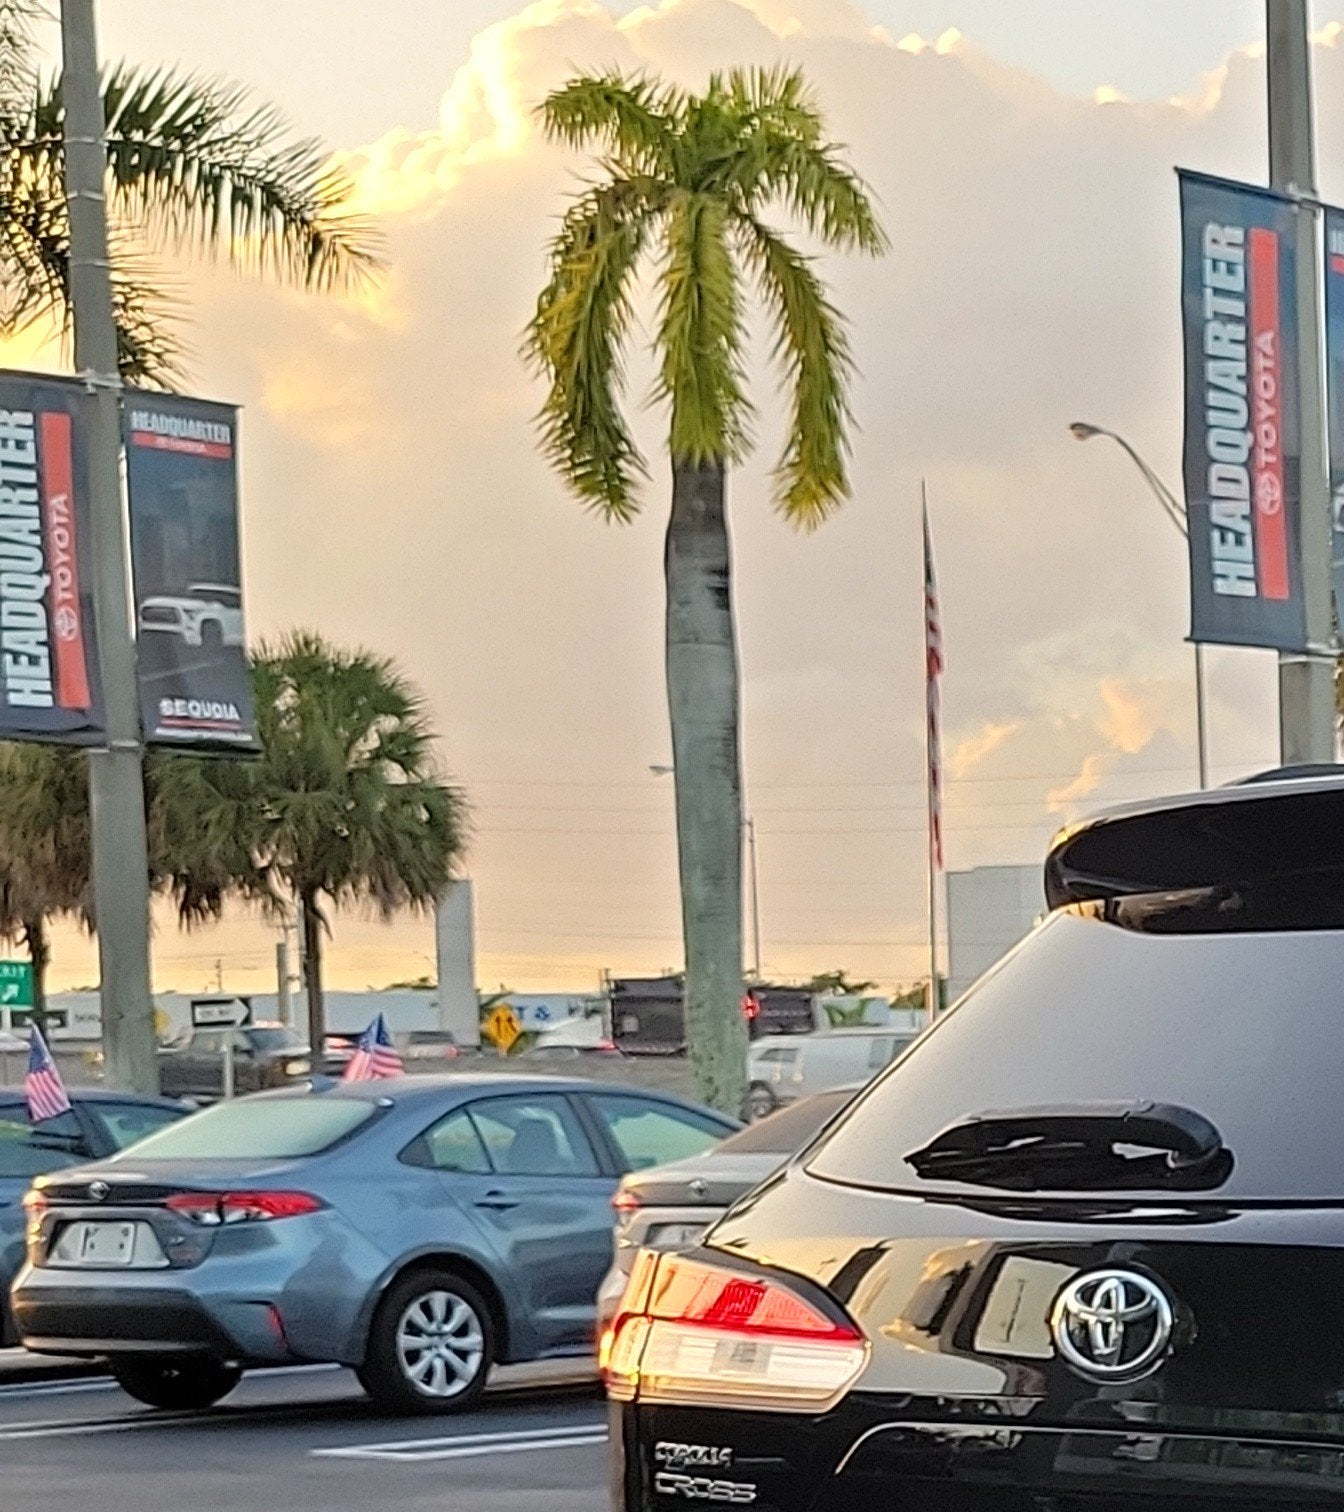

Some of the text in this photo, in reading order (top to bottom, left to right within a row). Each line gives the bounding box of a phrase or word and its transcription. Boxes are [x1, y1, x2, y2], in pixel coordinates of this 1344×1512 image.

[1204, 221, 1258, 598] HEADQUARTER
[1254, 330, 1280, 468] TOYOTA
[0, 409, 54, 708] HEADQUARTER
[50, 493, 74, 602] TOYOTA
[158, 696, 242, 722] SEQUOIA
[655, 1471, 758, 1503] CROSS
